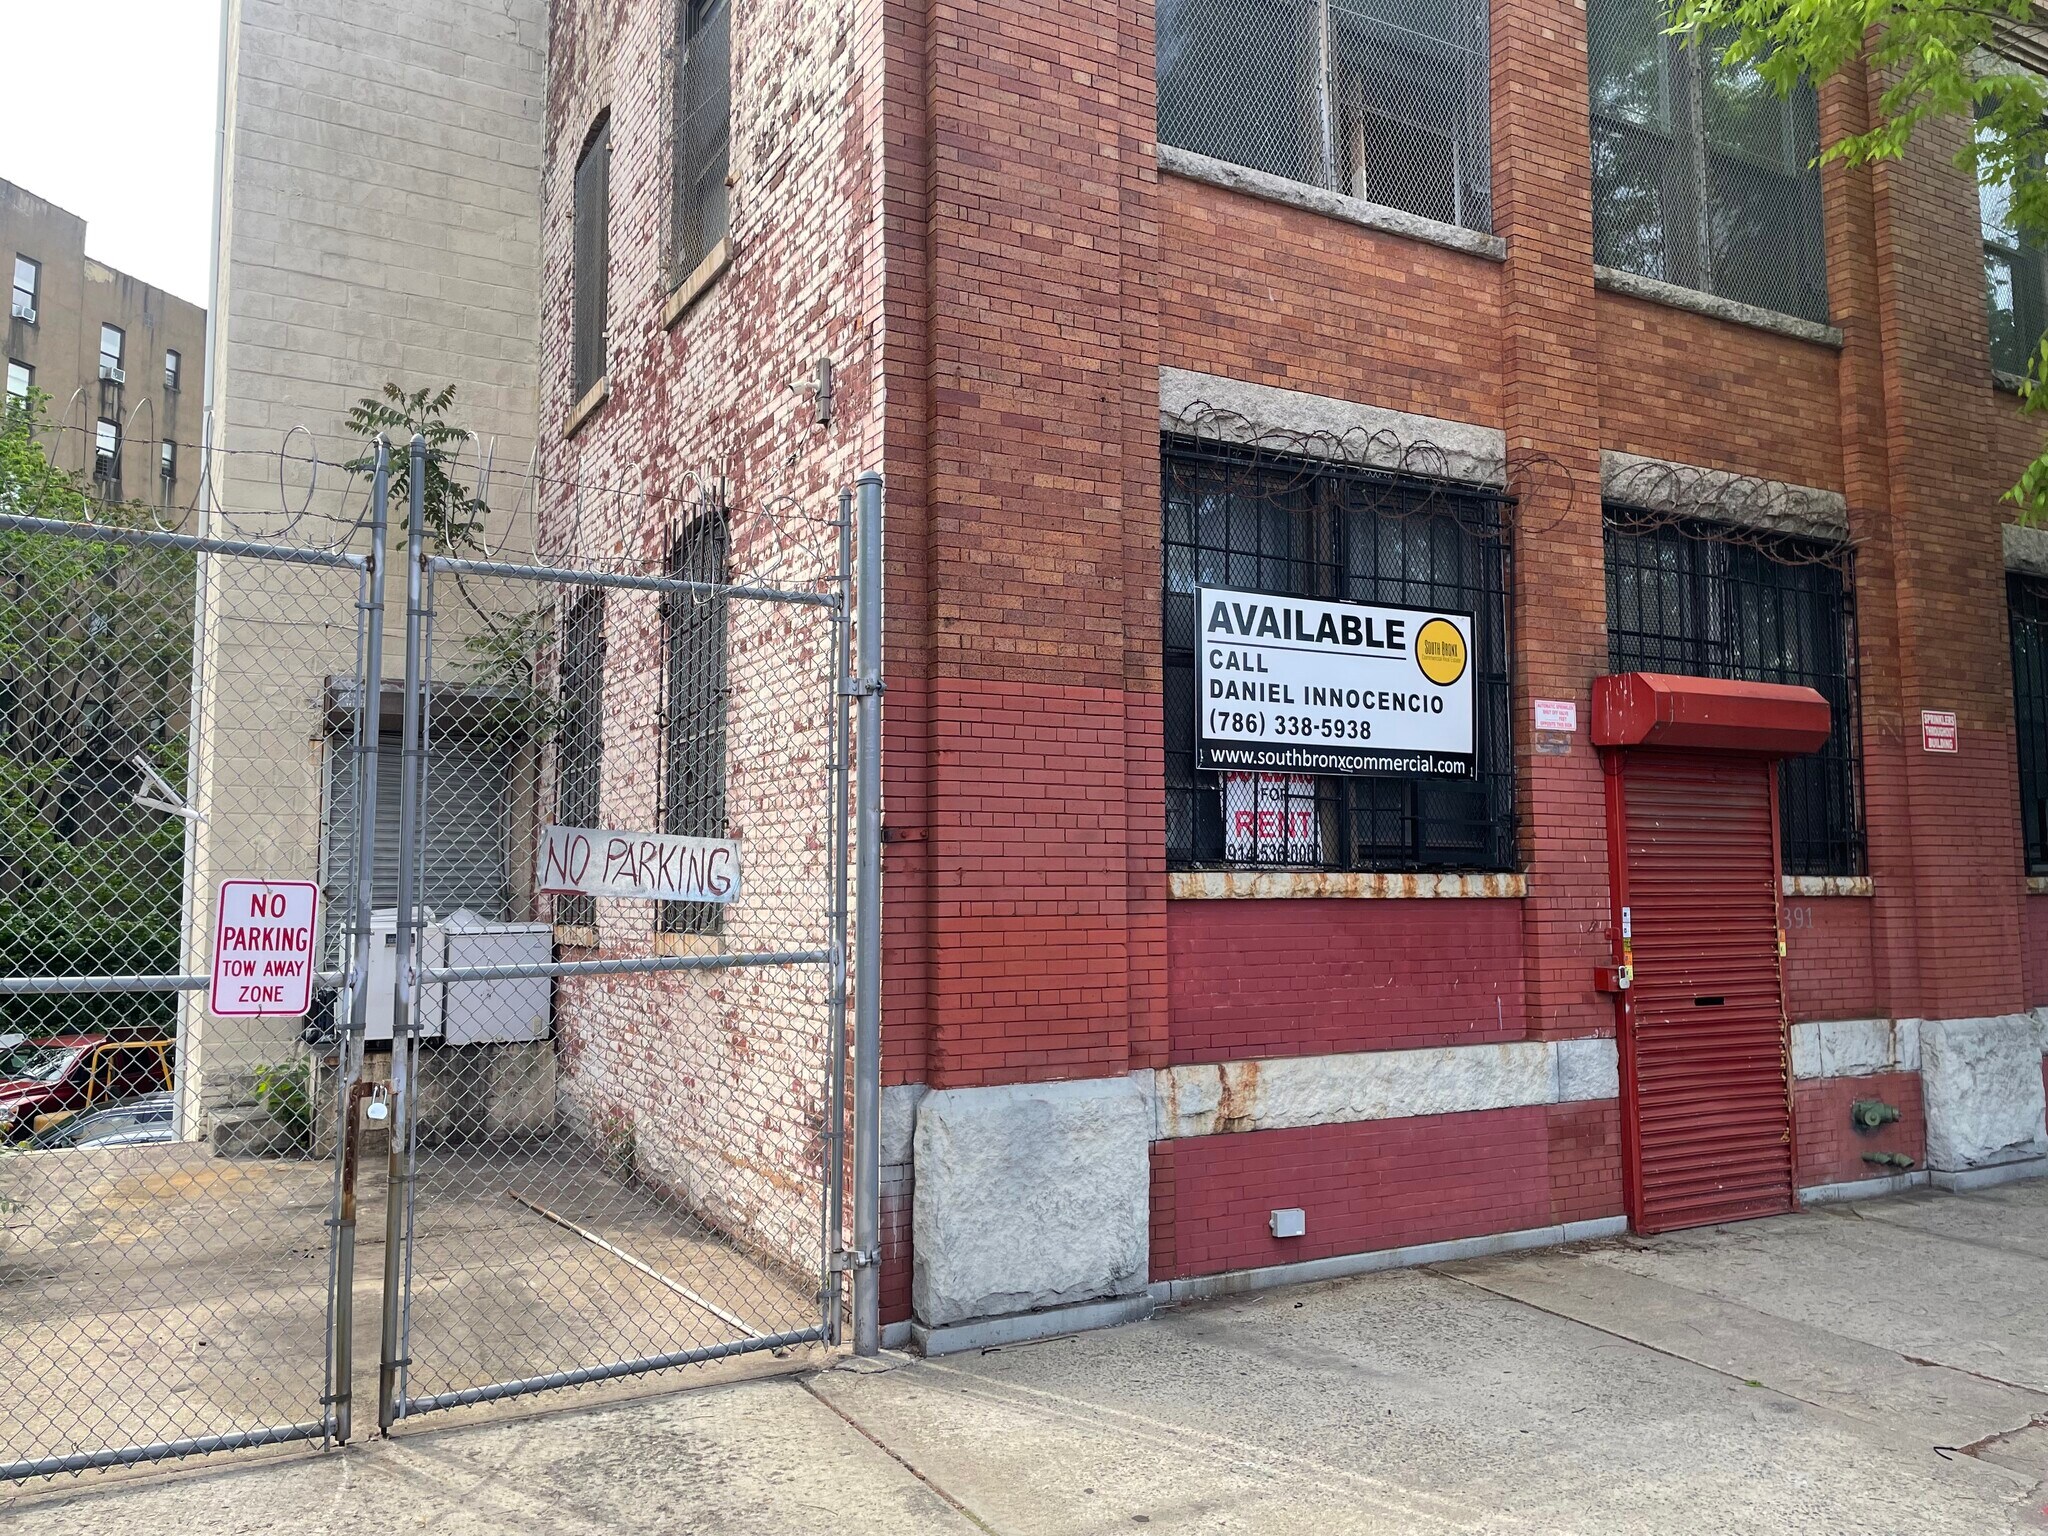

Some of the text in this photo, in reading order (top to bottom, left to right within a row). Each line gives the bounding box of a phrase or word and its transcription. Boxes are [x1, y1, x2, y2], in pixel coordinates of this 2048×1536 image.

[1207, 601, 1406, 650] AVAILABLE
[1209, 649, 1269, 673] CALL
[1425, 640, 1457, 657] SOUTH BRONX
[1210, 678, 1444, 714] DANIEL INNOCENCIO
[1209, 708, 1372, 740] (786) 338-5938
[1924, 714, 1954, 726] SPRINKLERS
[1928, 737, 1953, 749] BUILDING
[1211, 747, 1466, 774] www.southbronxcommercial.com
[1235, 810, 1312, 840] RENT
[545, 833, 731, 897] NO PARKING
[250, 893, 286, 918] NO
[1784, 907, 1814, 930] 391
[223, 926, 308, 952] PARKING
[223, 960, 304, 977] TOW AWAY
[239, 986, 284, 1002] ZONE
